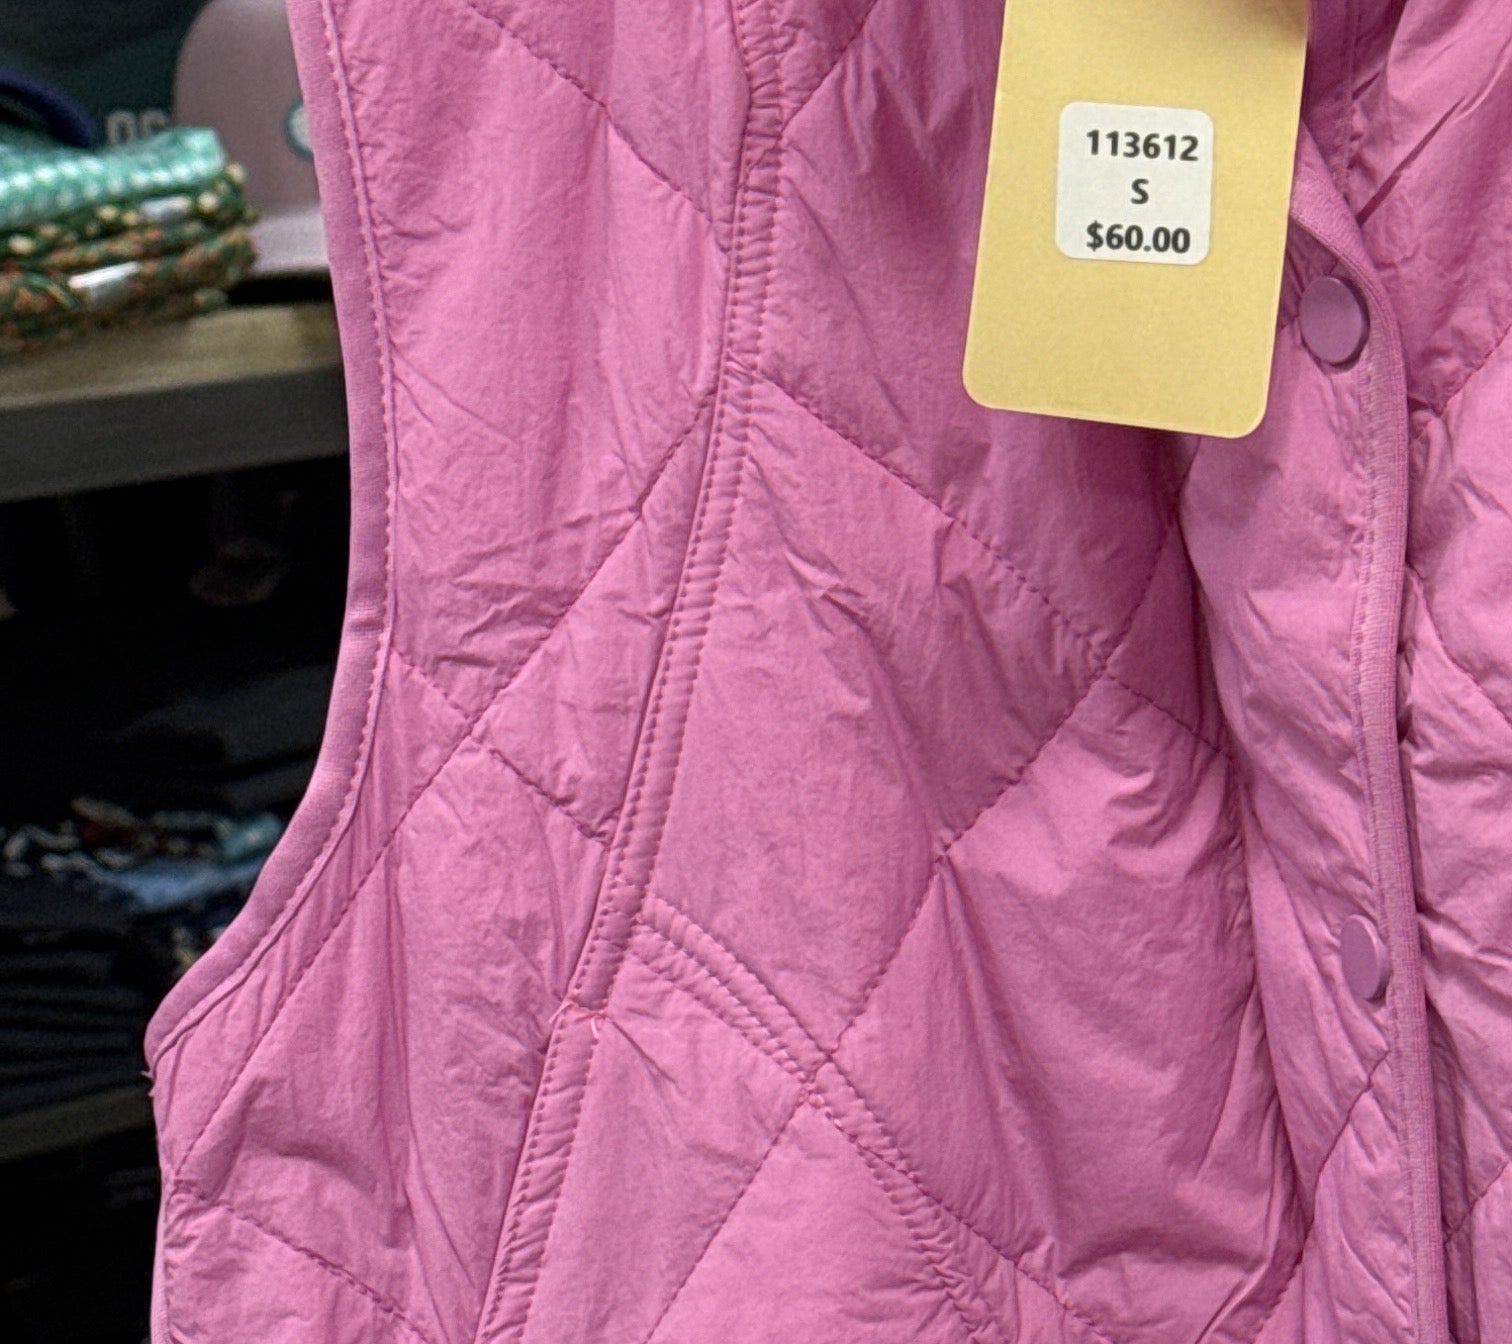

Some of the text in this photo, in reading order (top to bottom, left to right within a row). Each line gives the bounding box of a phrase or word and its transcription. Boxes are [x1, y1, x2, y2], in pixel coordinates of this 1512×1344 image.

[1086, 129, 1199, 161] 113612
[1130, 178, 1149, 205] S
[1086, 220, 1191, 254] $60.00
